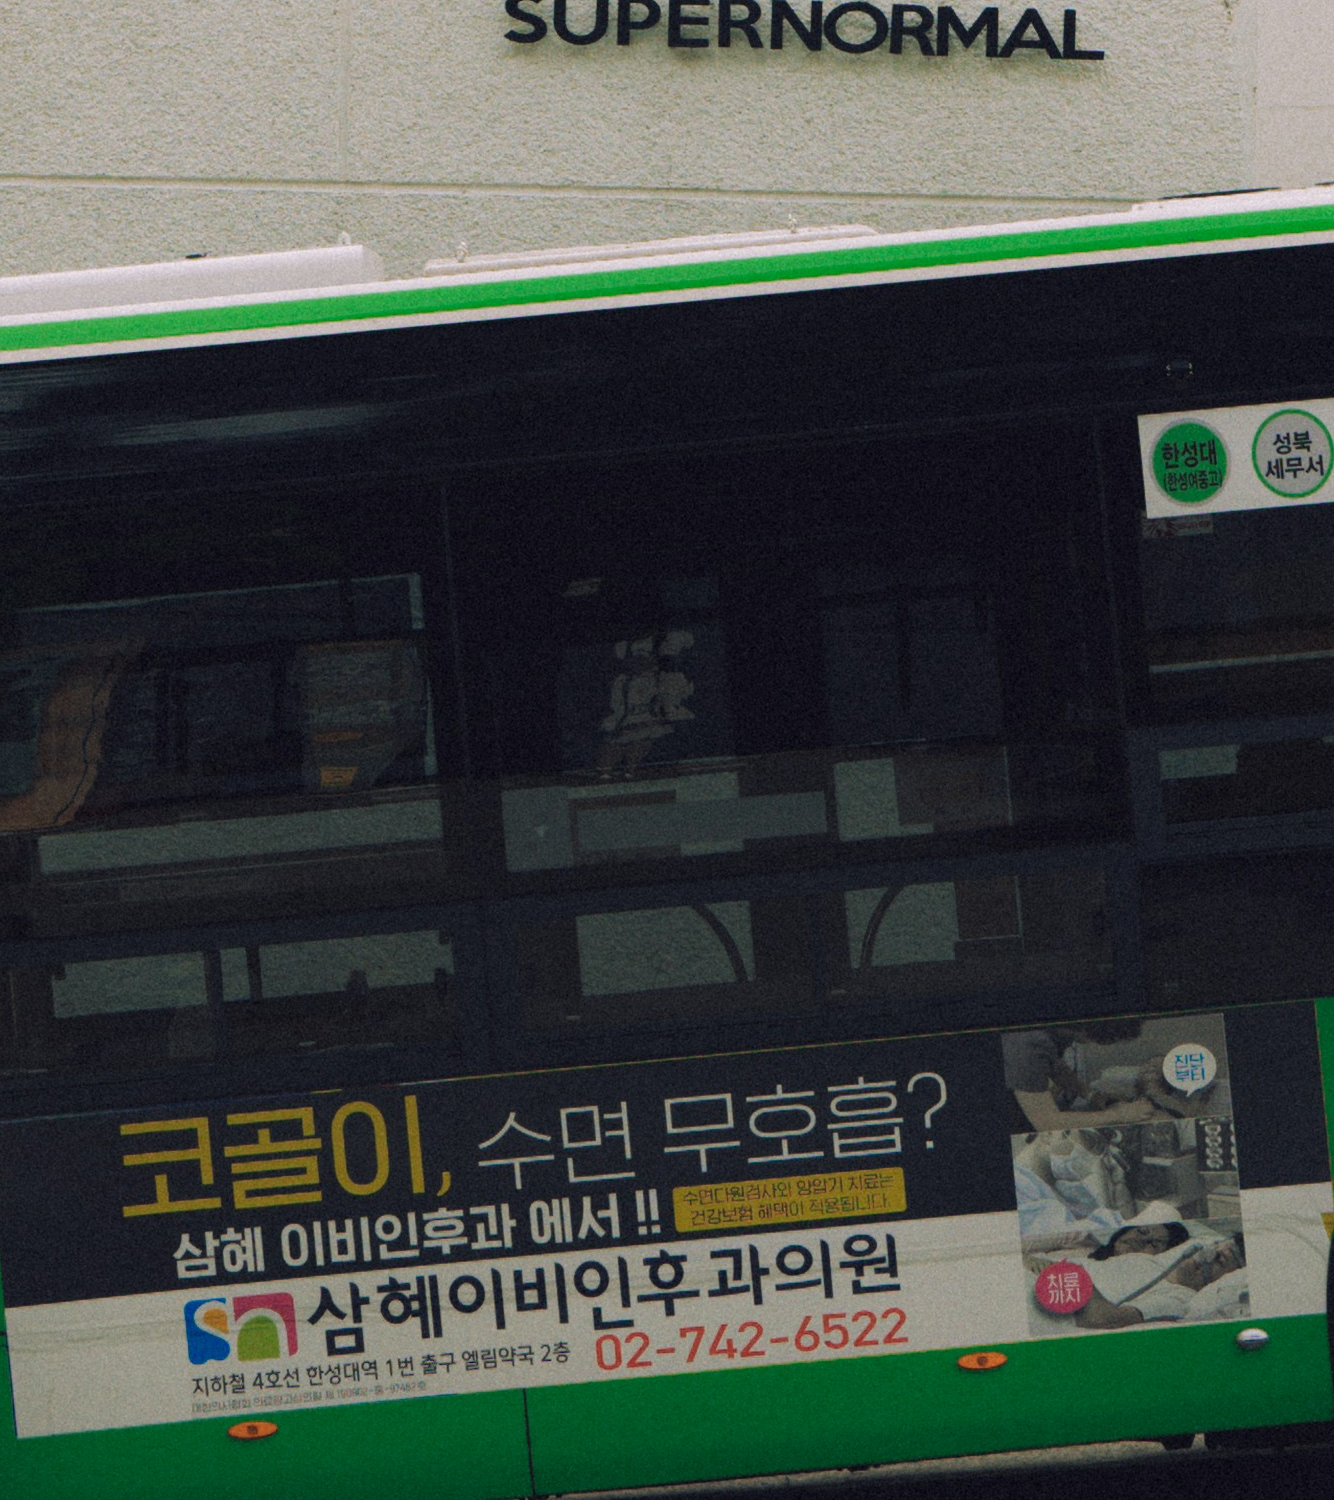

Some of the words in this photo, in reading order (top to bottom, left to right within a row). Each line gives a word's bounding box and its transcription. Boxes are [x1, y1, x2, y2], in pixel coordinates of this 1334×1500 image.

[1161, 438, 1218, 470] 한성대
[1273, 430, 1313, 455] 성북
[1265, 454, 1325, 480] 세무서
[1164, 469, 1224, 493] (한성여중고)
[1175, 1052, 1205, 1069] 진단
[1175, 1067, 1205, 1081] 부터
[119, 1094, 453, 1219] 코골이,
[478, 1101, 636, 1190] 수면
[663, 1071, 948, 1174] 무호흡?
[848, 1172, 895, 1190] 치료는
[691, 1205, 754, 1227] 건강보험
[172, 1226, 264, 1279] 삼혜
[280, 1206, 516, 1271] 이비인후과
[530, 1194, 621, 1245] 에서
[1047, 1272, 1080, 1289] 치료
[1048, 1288, 1081, 1304] 까지
[595, 1308, 909, 1370] 02-742-6522
[192, 1374, 246, 1398] 지하철
[252, 1366, 301, 1391] 4호선
[307, 1360, 379, 1387] 한성대역
[386, 1356, 415, 1378] 1번
[421, 1353, 456, 1375] 출구
[461, 1346, 535, 1371] 엘림약국
[540, 1341, 571, 1365] 2층
